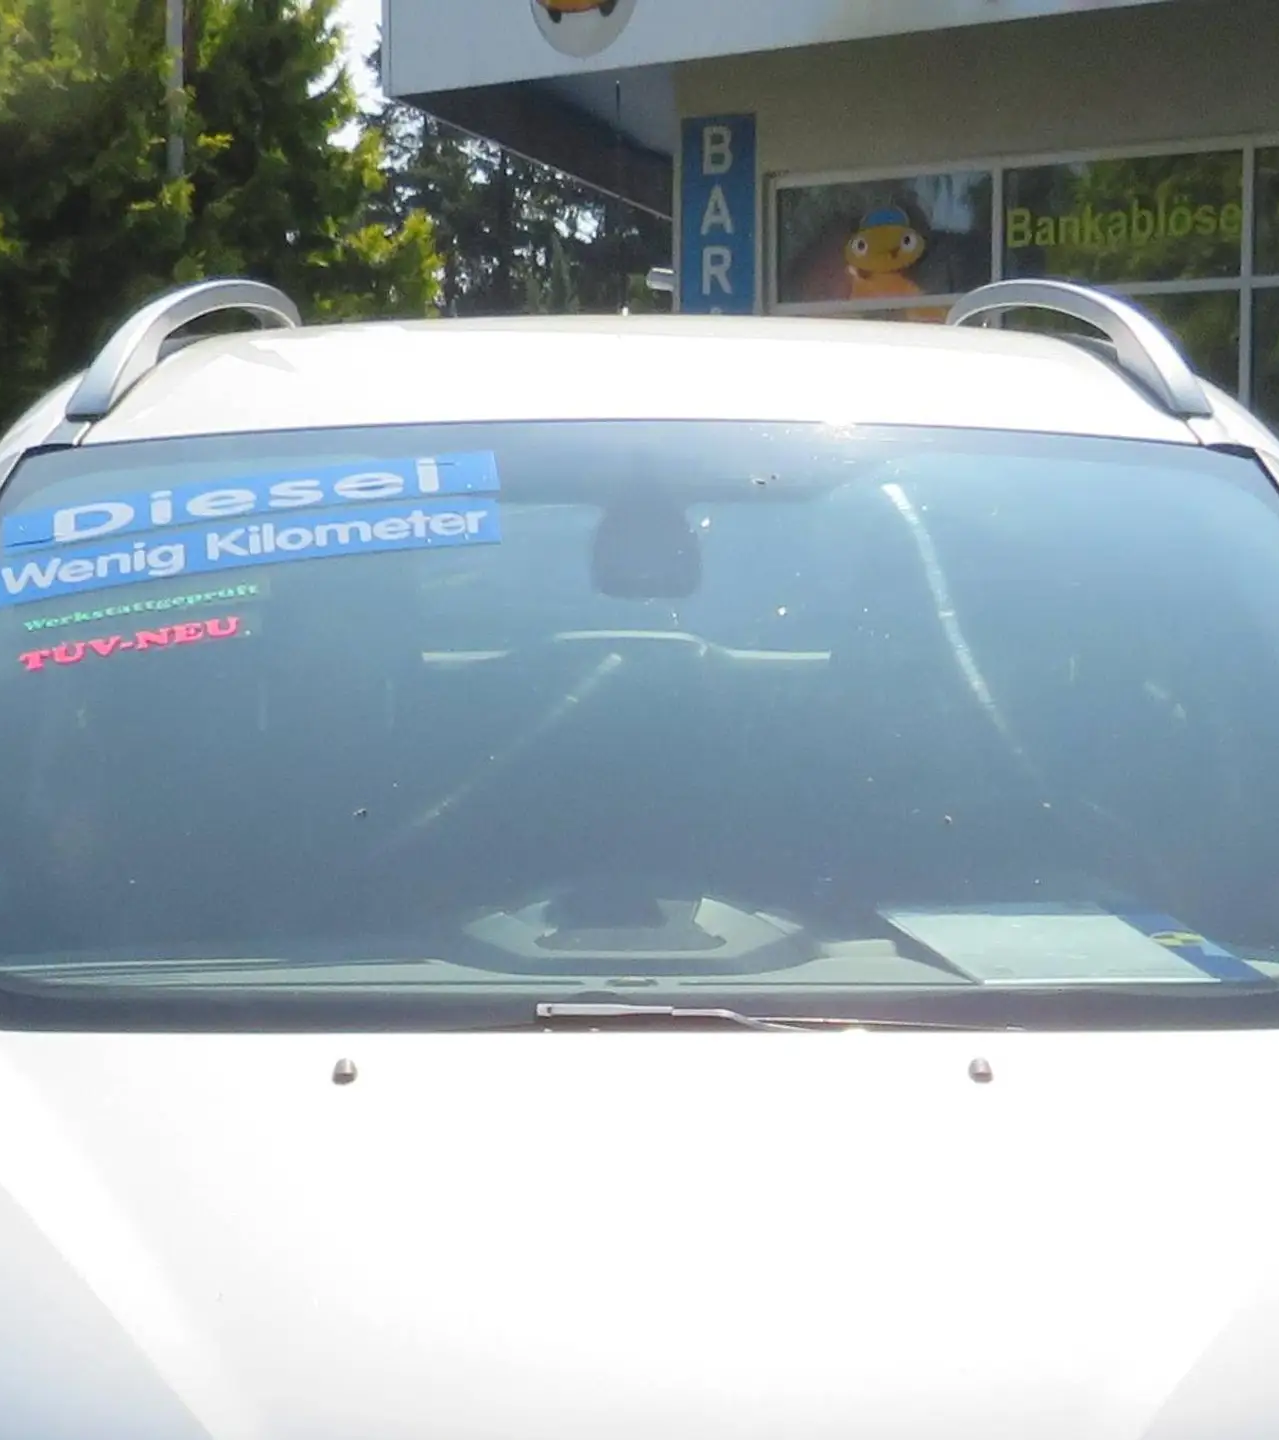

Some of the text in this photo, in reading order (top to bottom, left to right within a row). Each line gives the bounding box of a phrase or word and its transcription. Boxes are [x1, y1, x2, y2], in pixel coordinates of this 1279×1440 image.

[1006, 193, 1242, 248] Bankablöse
[52, 457, 441, 543] Diesel
[1, 507, 488, 596] Wenig Kilometer
